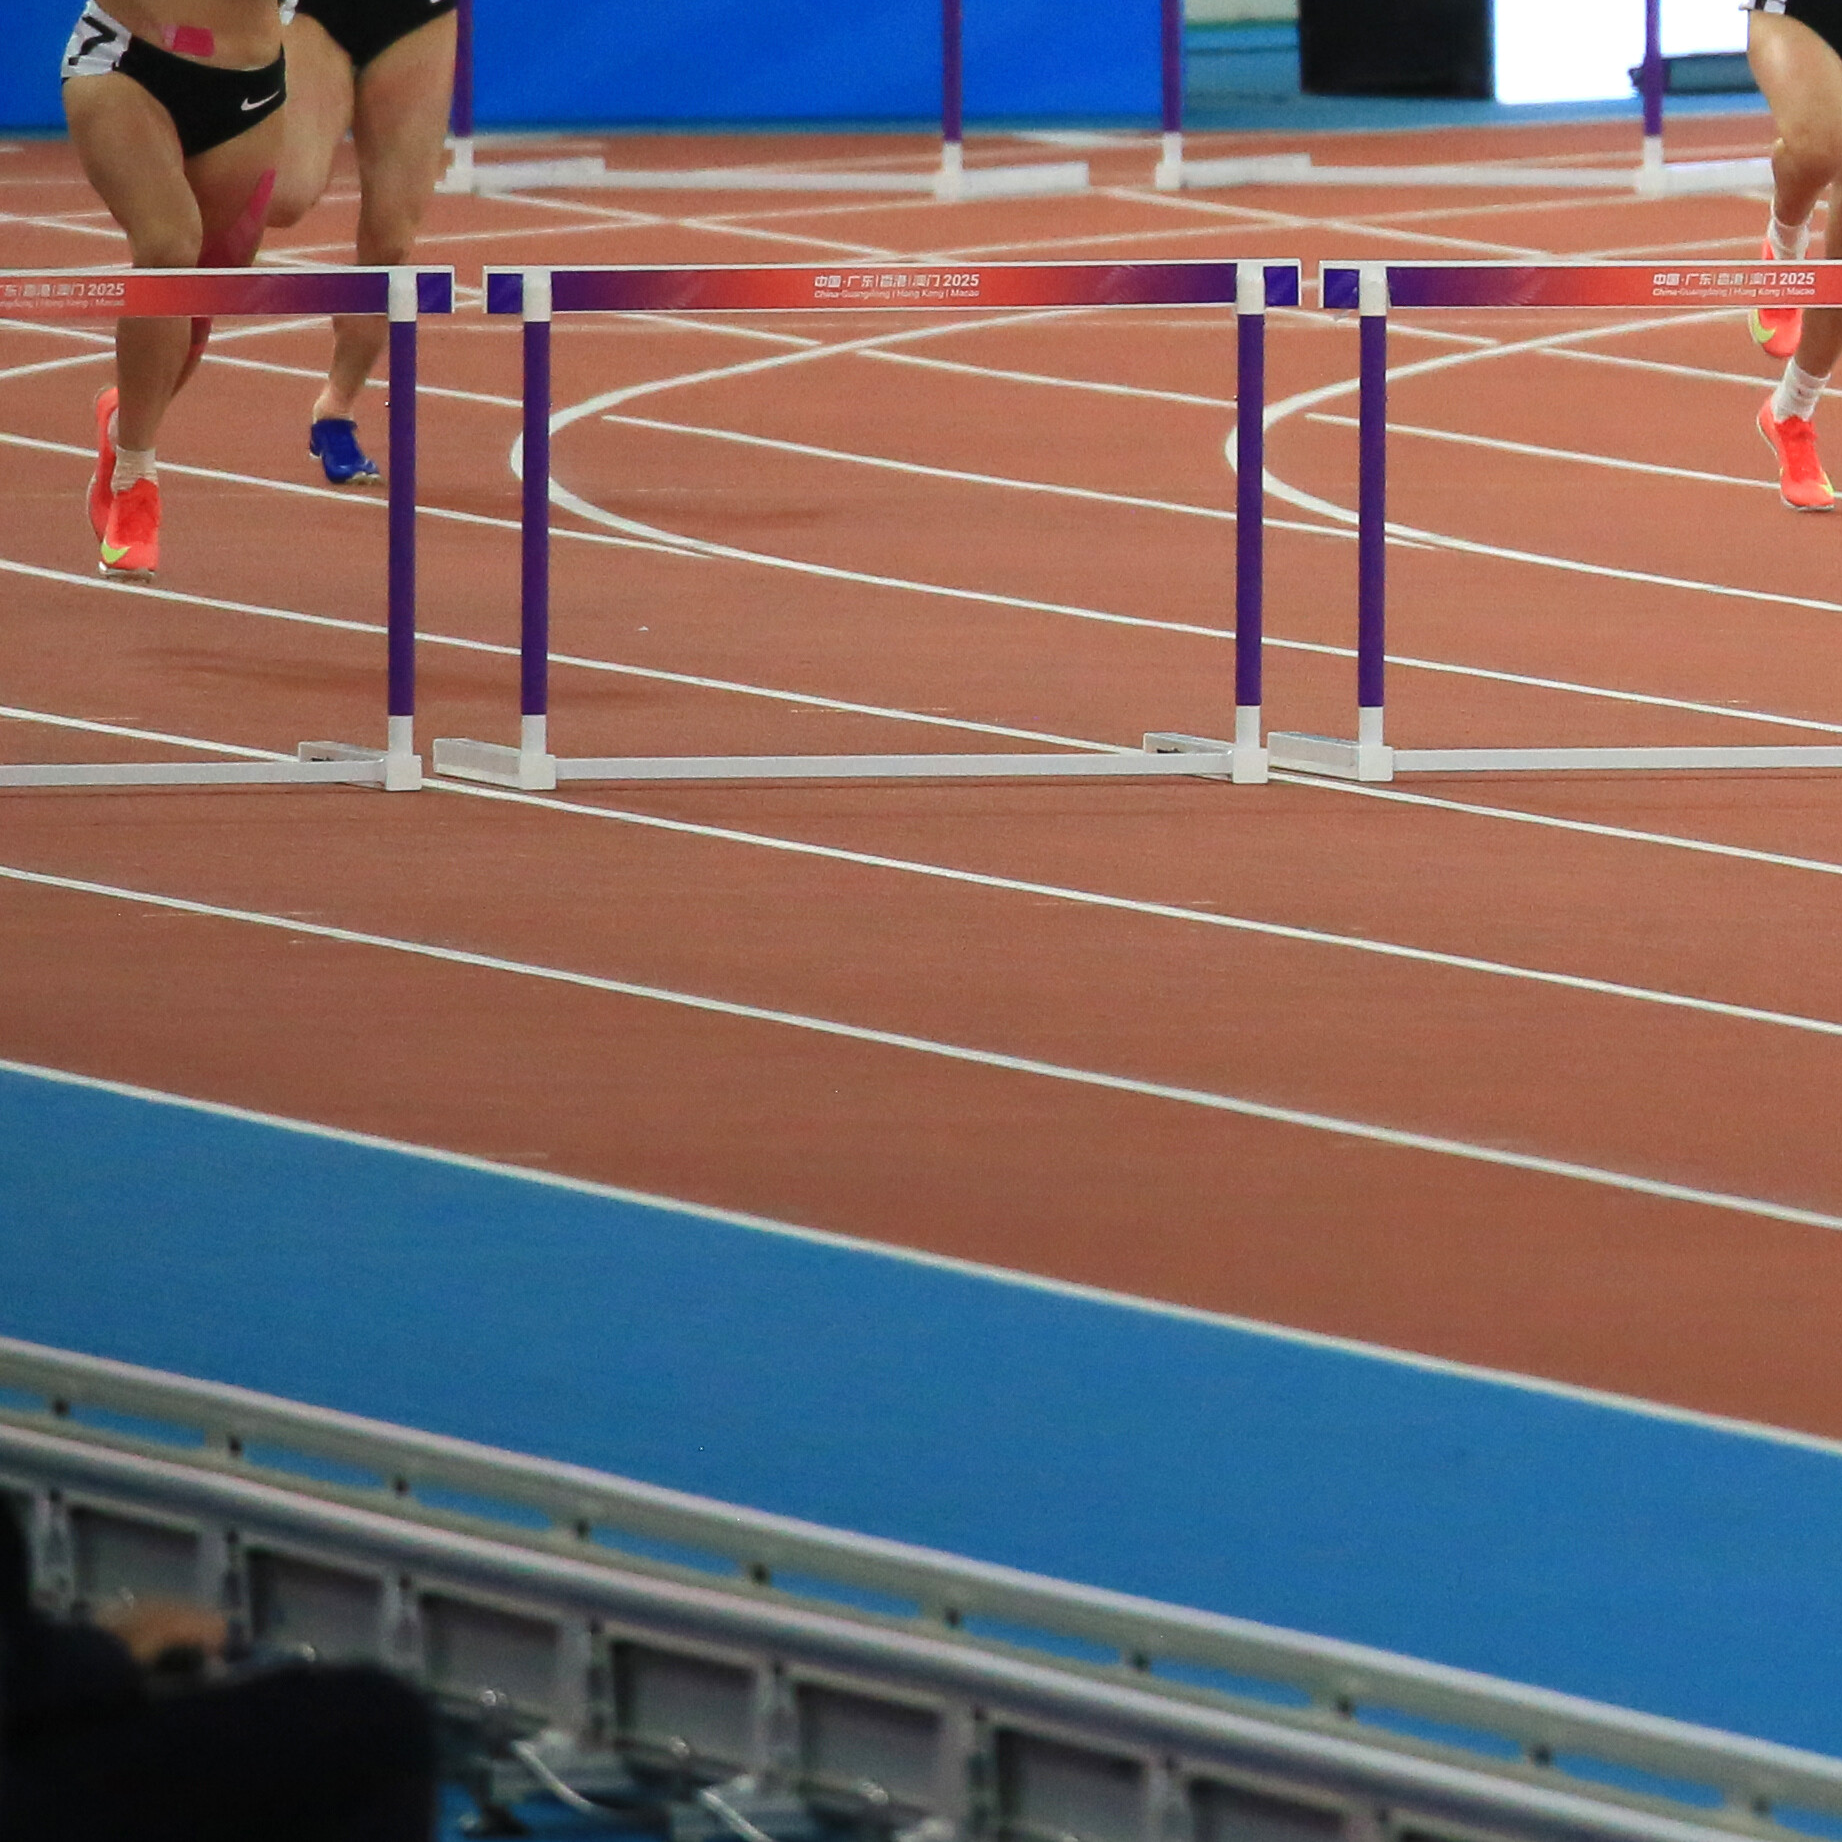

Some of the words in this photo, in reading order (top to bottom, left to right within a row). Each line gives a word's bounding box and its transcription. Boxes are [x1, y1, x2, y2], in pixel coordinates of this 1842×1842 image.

[942, 274, 980, 287] 2025
[1779, 272, 1815, 285] 2025
[87, 282, 126, 296] 2025
